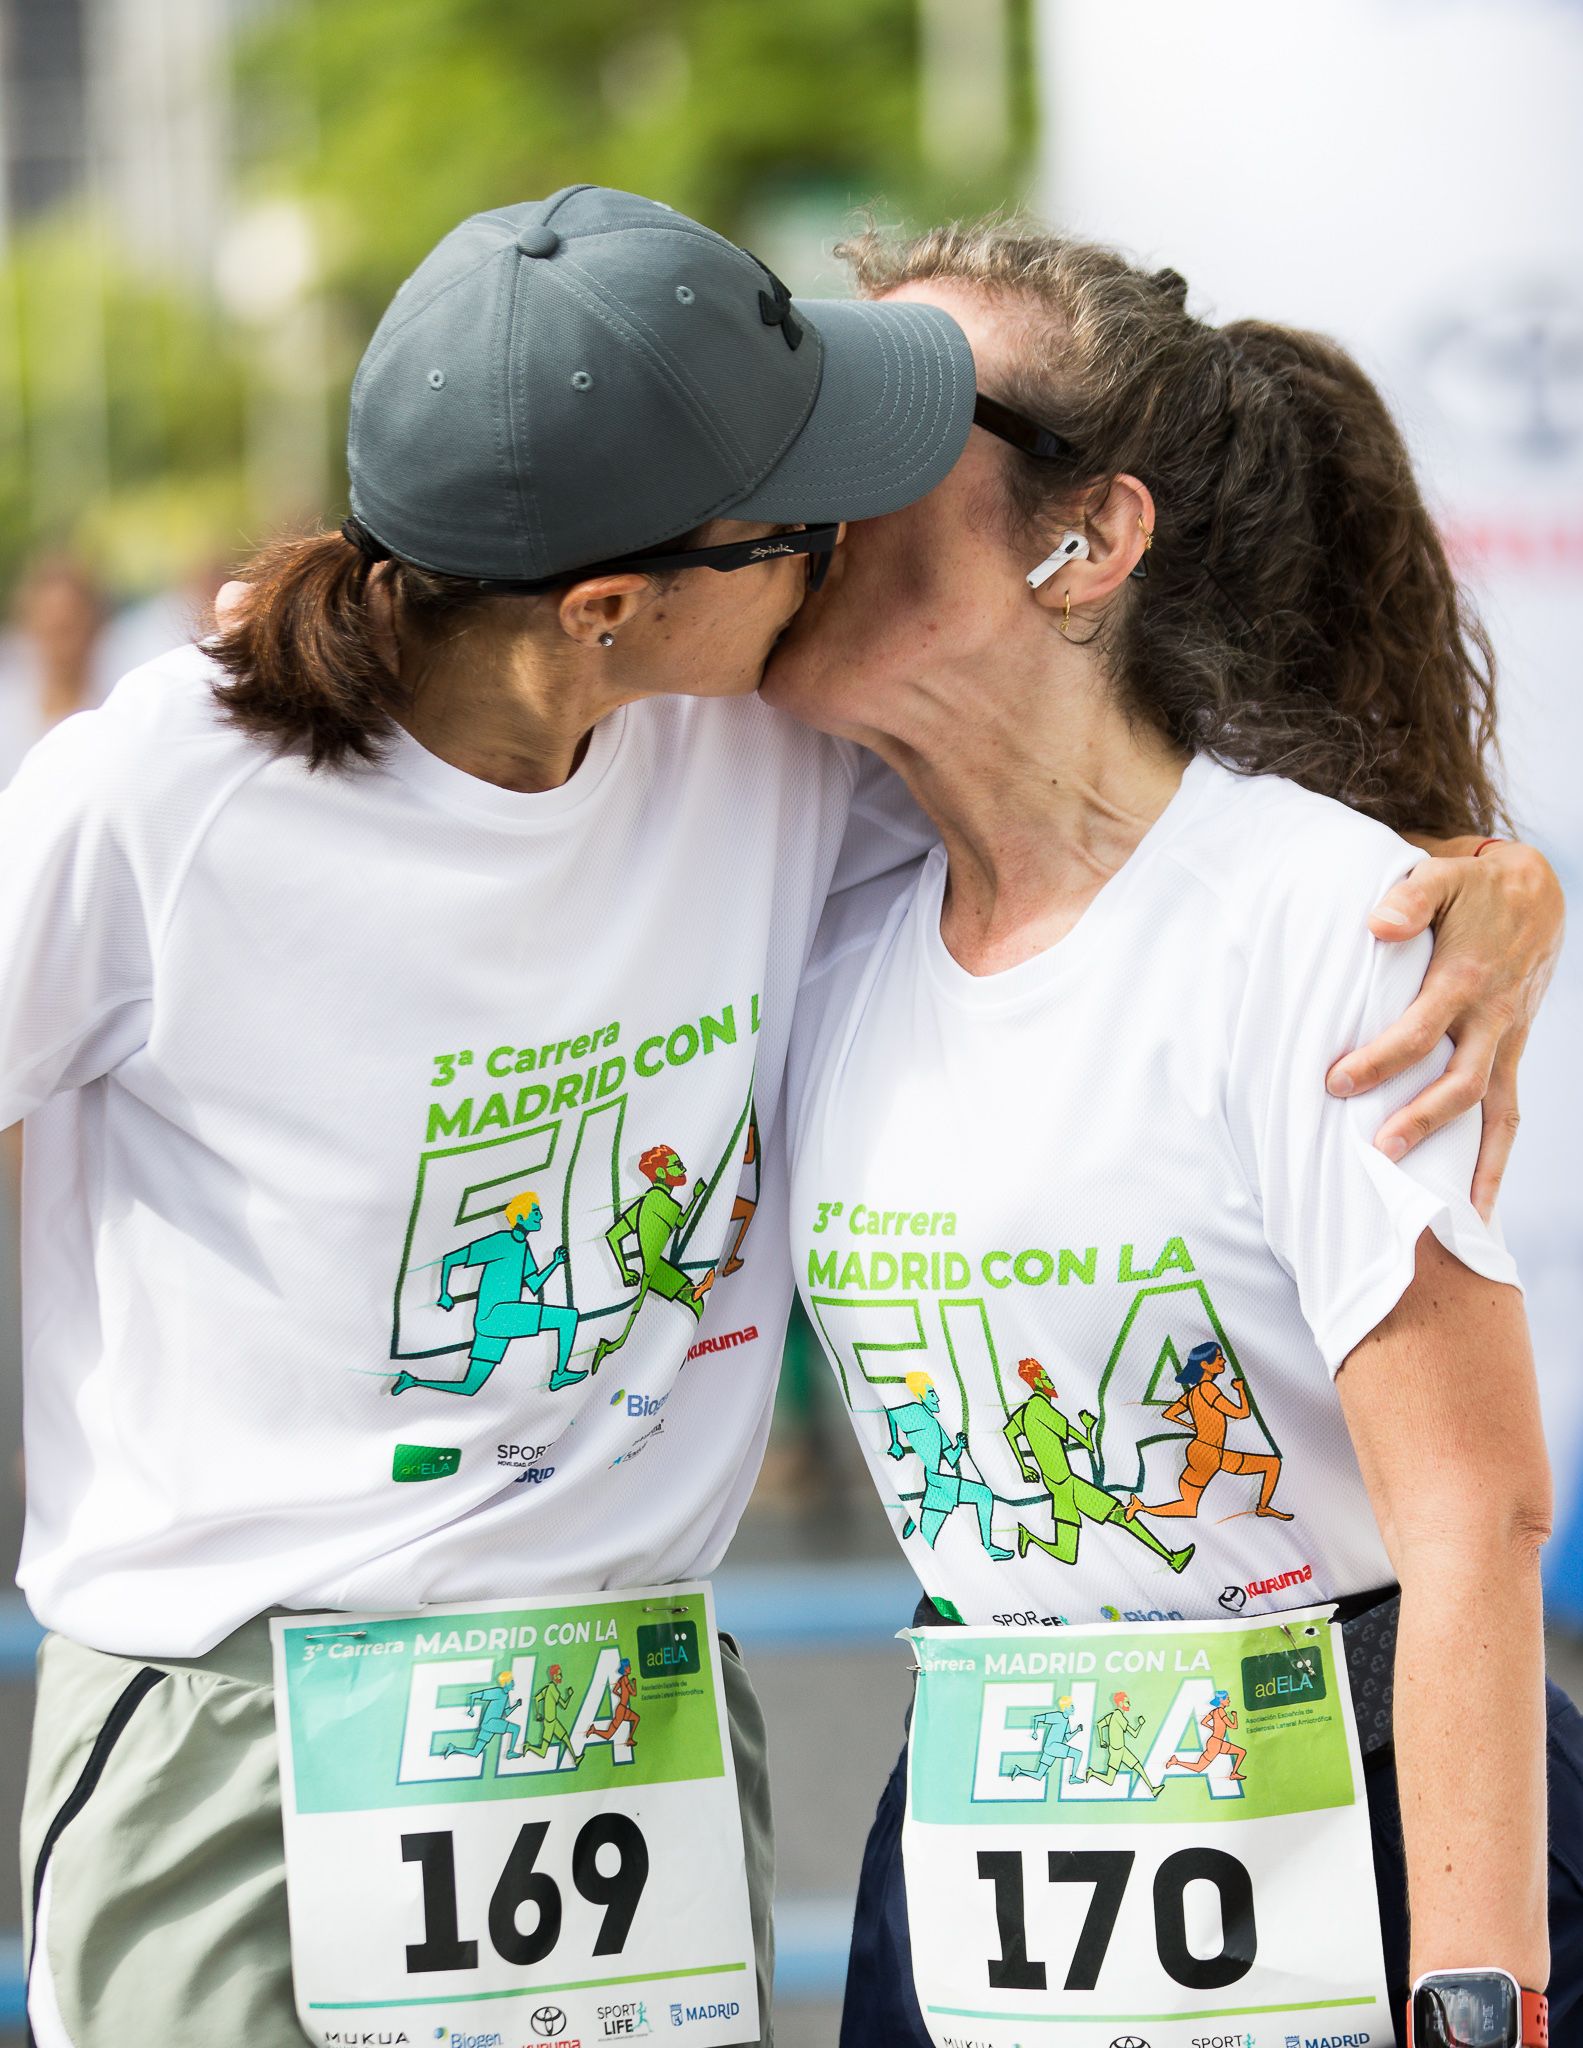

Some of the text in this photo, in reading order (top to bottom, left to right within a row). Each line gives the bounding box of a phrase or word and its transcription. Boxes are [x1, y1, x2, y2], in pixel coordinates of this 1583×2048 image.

[430, 1021, 621, 1087] 3ª Carrera
[426, 1056, 626, 1144] MADRID
[633, 1003, 737, 1078] CON
[812, 1201, 957, 1236] 3ª Carrera
[808, 1236, 1196, 1291] MADRID CON LA
[497, 1444, 555, 1460] SPOR
[329, 1640, 405, 1659] Carrera
[414, 1626, 537, 1656] MADRID
[544, 1621, 590, 1646] CON
[595, 1618, 618, 1641] LA
[646, 1645, 689, 1667] adELA
[925, 1649, 1212, 1675] arrera MADRID CON LA
[1255, 1672, 1313, 1698] adELA
[396, 1645, 636, 1785] ELA
[970, 1677, 1246, 1804] ELA
[400, 1811, 650, 1974] 169
[976, 1846, 1258, 1991] 170
[597, 2003, 636, 2020] SPORT
[686, 2002, 740, 2020] MADRID
[325, 2031, 410, 2044] MUKUA
[604, 2019, 634, 2035] LIFE
[1305, 2032, 1370, 2048] MADRID
[1191, 2034, 1243, 2048] SPORT
